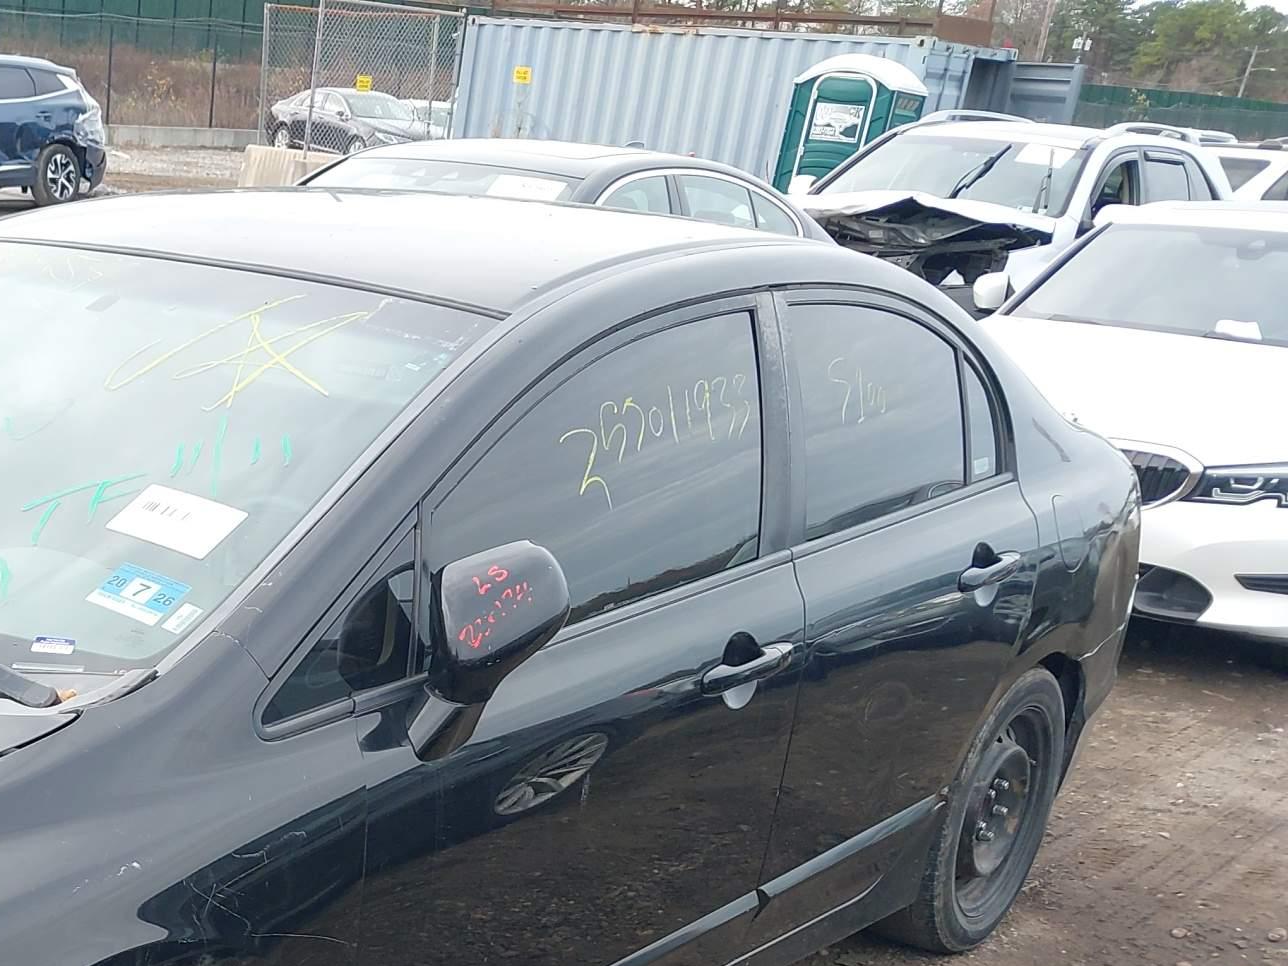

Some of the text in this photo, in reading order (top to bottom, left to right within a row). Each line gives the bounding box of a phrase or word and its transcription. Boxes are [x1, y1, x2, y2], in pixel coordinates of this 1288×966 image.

[106, 575, 128, 589] 20
[131, 582, 153, 598] 7
[152, 592, 176, 607] 26
